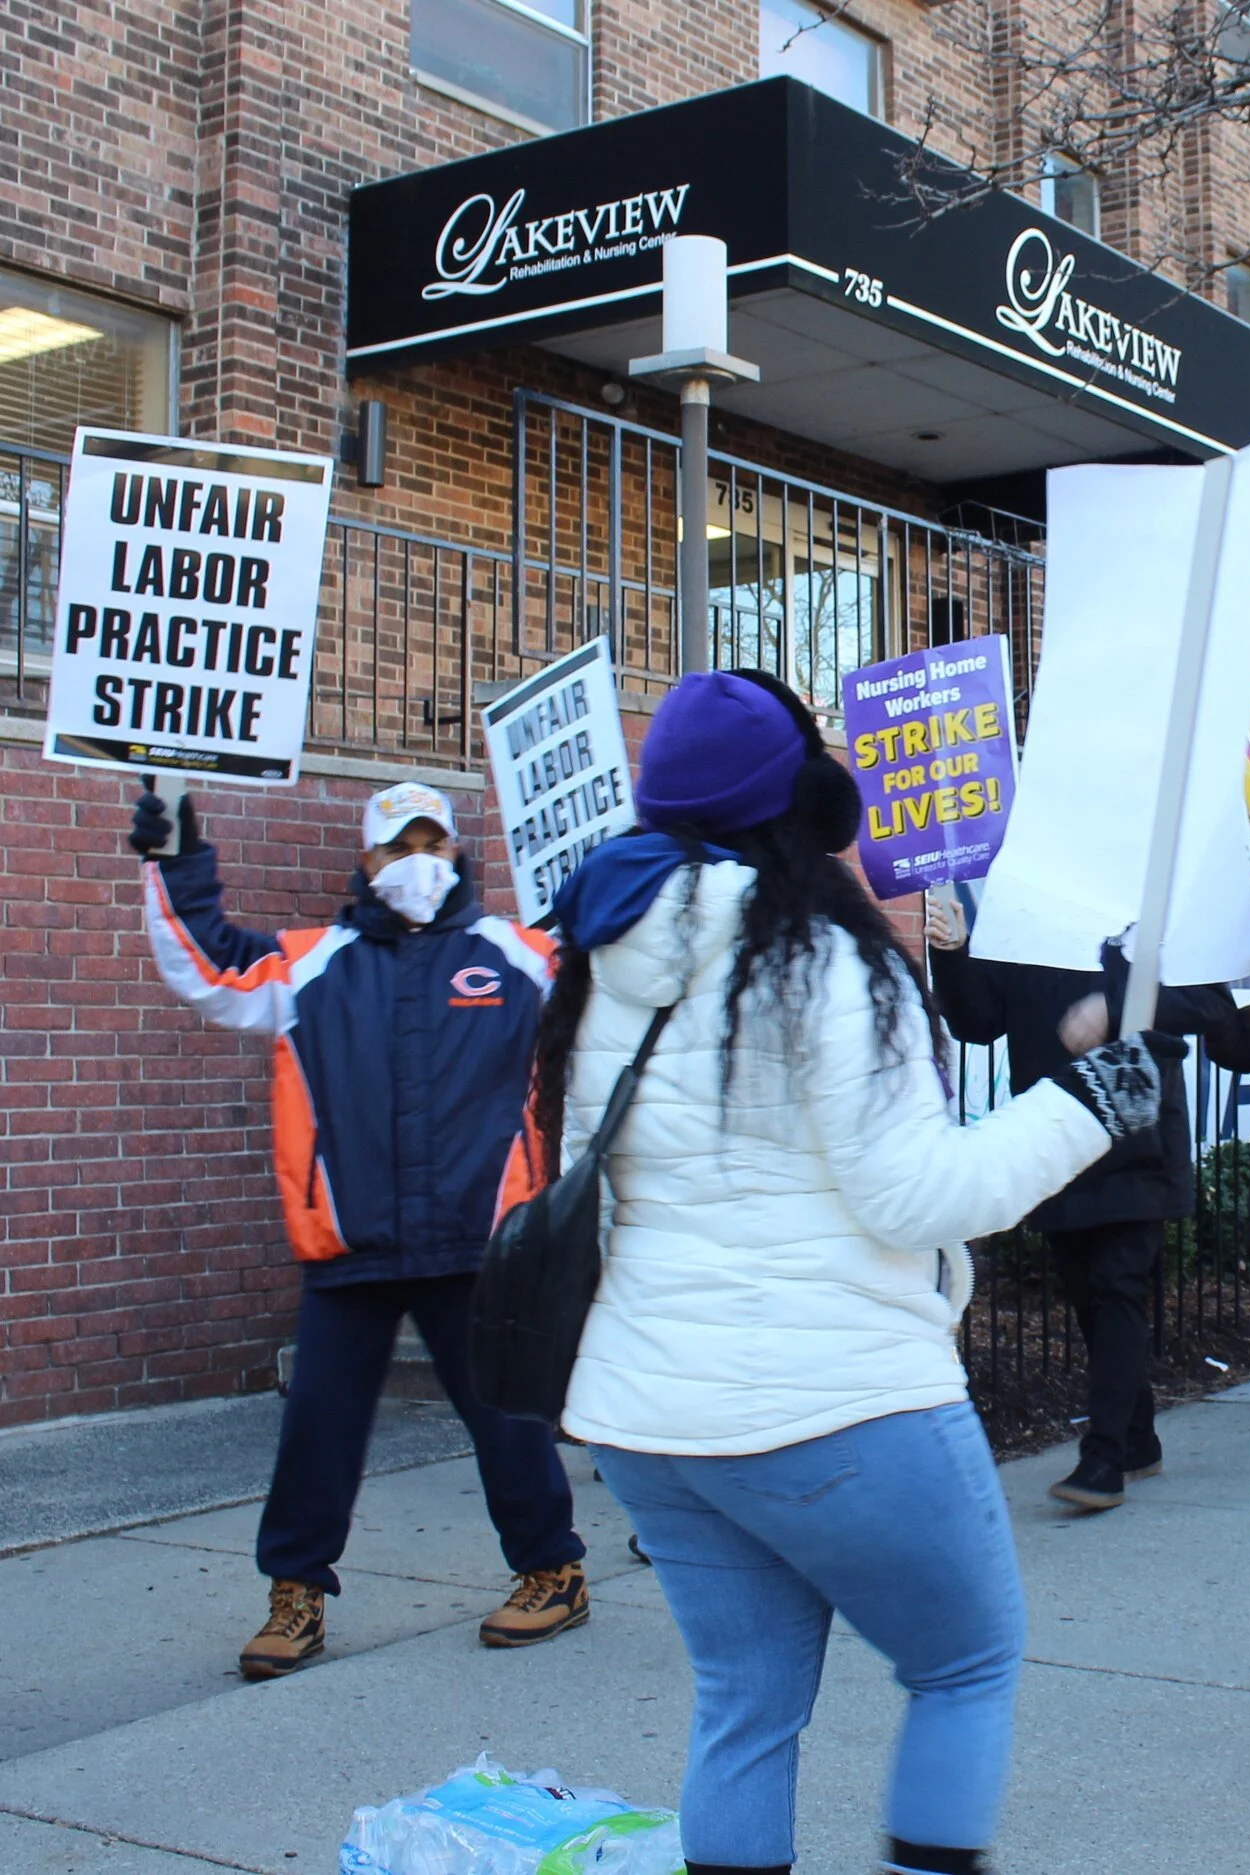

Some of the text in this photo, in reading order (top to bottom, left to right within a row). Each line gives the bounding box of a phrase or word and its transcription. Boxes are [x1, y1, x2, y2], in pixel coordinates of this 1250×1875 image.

[510, 255, 581, 281] Rehabilitation
[583, 249, 591, 264] &
[594, 240, 636, 262] Nursing
[842, 269, 883, 308] 735
[1067, 340, 1117, 378] Rehabilitation
[1125, 368, 1152, 396] Nursing
[1152, 381, 1176, 404] Center
[110, 471, 285, 543] UNFAIR
[111, 540, 271, 609] LABOR
[65, 603, 302, 681] PRACTICE
[93, 674, 264, 743] STRIKE
[856, 655, 987, 701] Nursing Home
[884, 686, 961, 718] Workers
[505, 679, 589, 761] UNFAIR
[854, 702, 1002, 770] STRIKE
[517, 729, 594, 806] LABOR
[883, 753, 979, 794] FOR OUR
[511, 766, 623, 866] PRACTICE
[868, 777, 1002, 841] LIVES!
